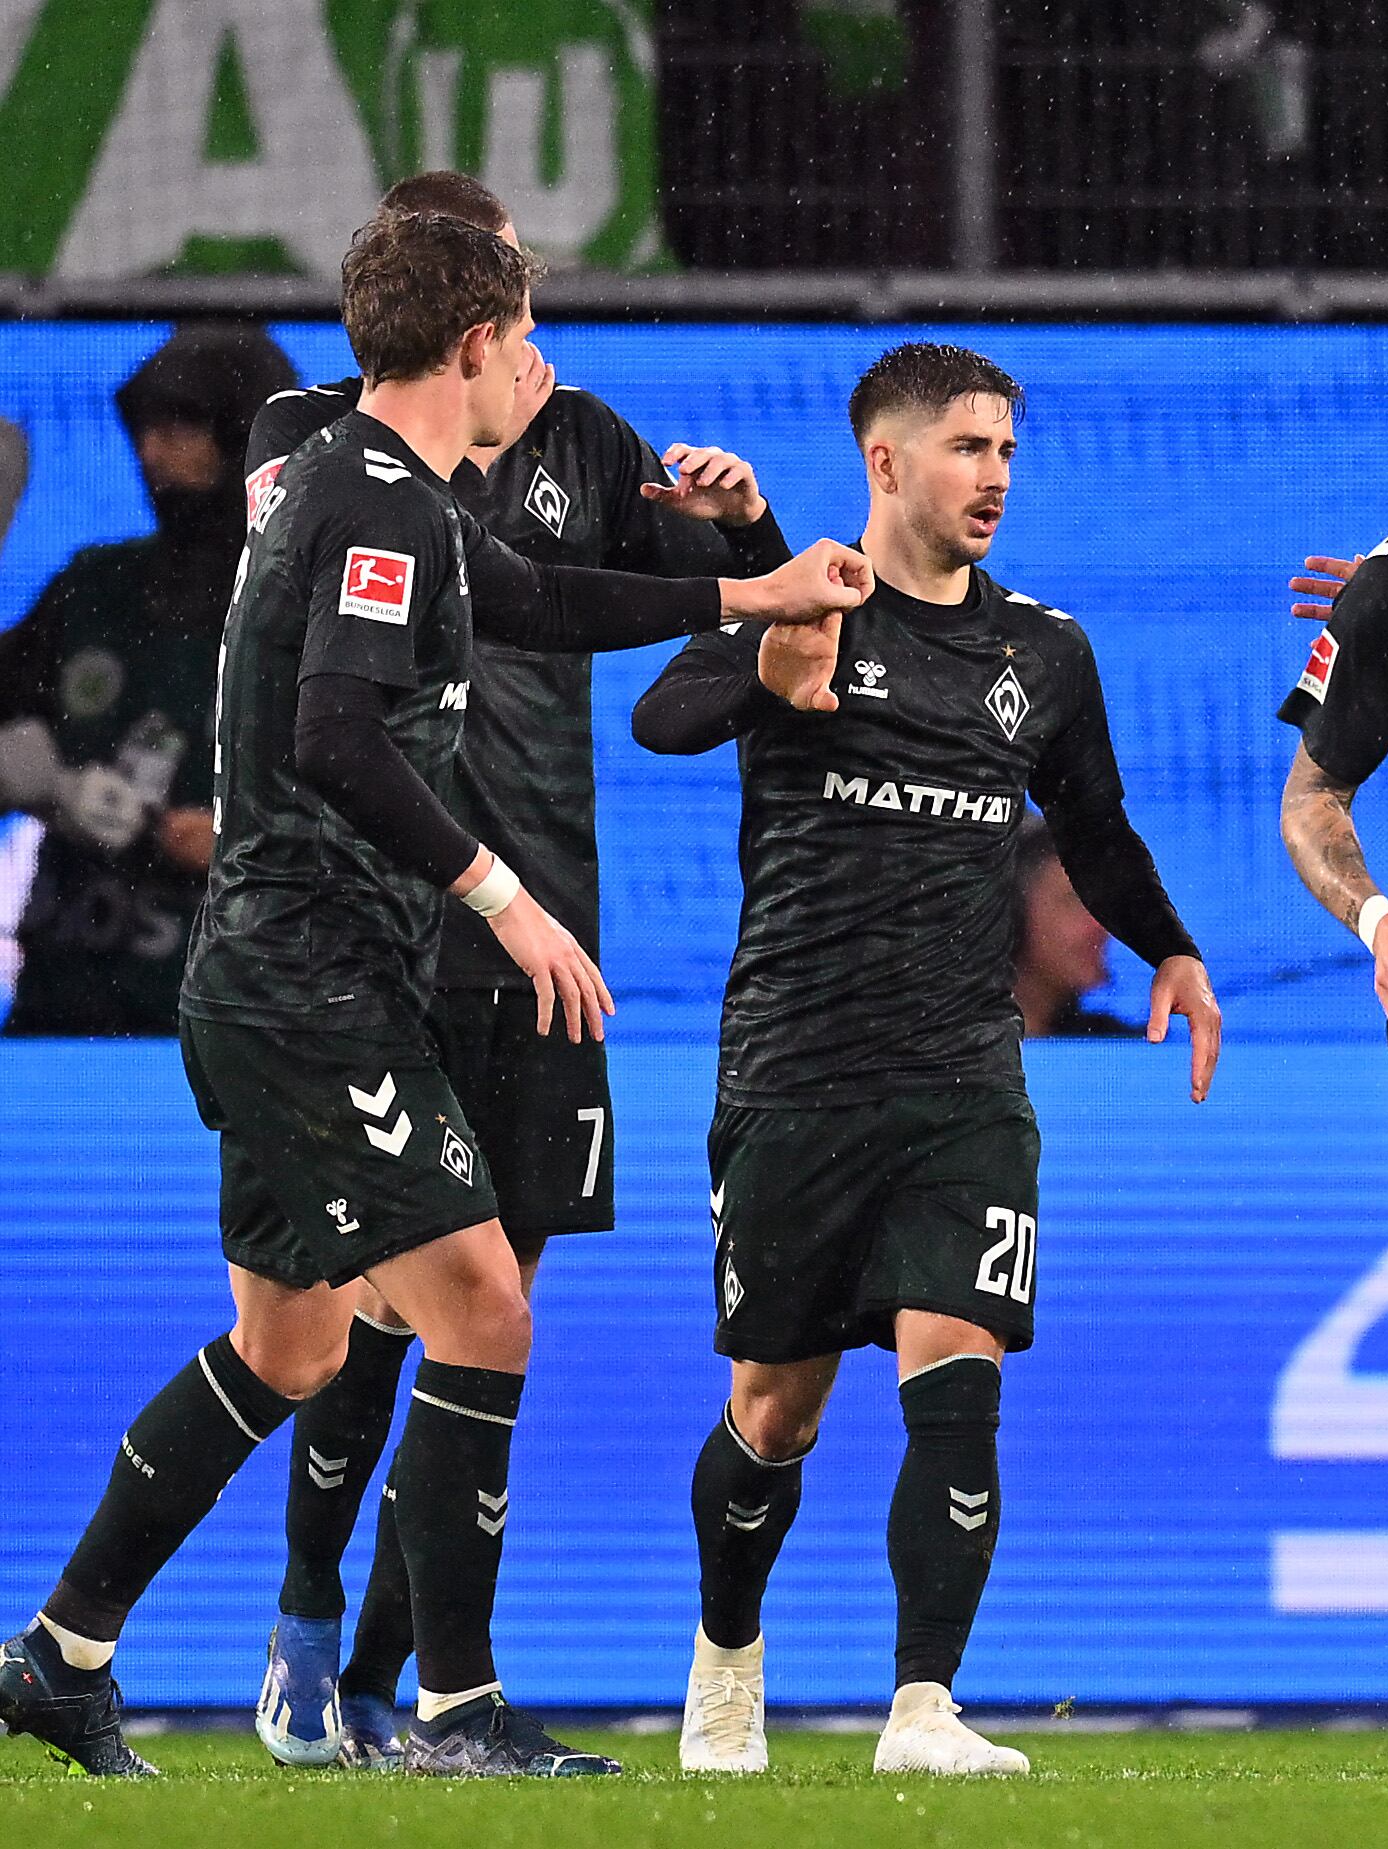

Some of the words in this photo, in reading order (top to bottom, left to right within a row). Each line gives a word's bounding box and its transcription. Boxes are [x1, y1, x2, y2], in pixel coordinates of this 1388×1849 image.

[345, 601, 401, 617] BUNDESLIGA
[823, 772, 1011, 822] MATTHÄI
[577, 1107, 605, 1198] 7
[974, 1205, 1037, 1305] 20
